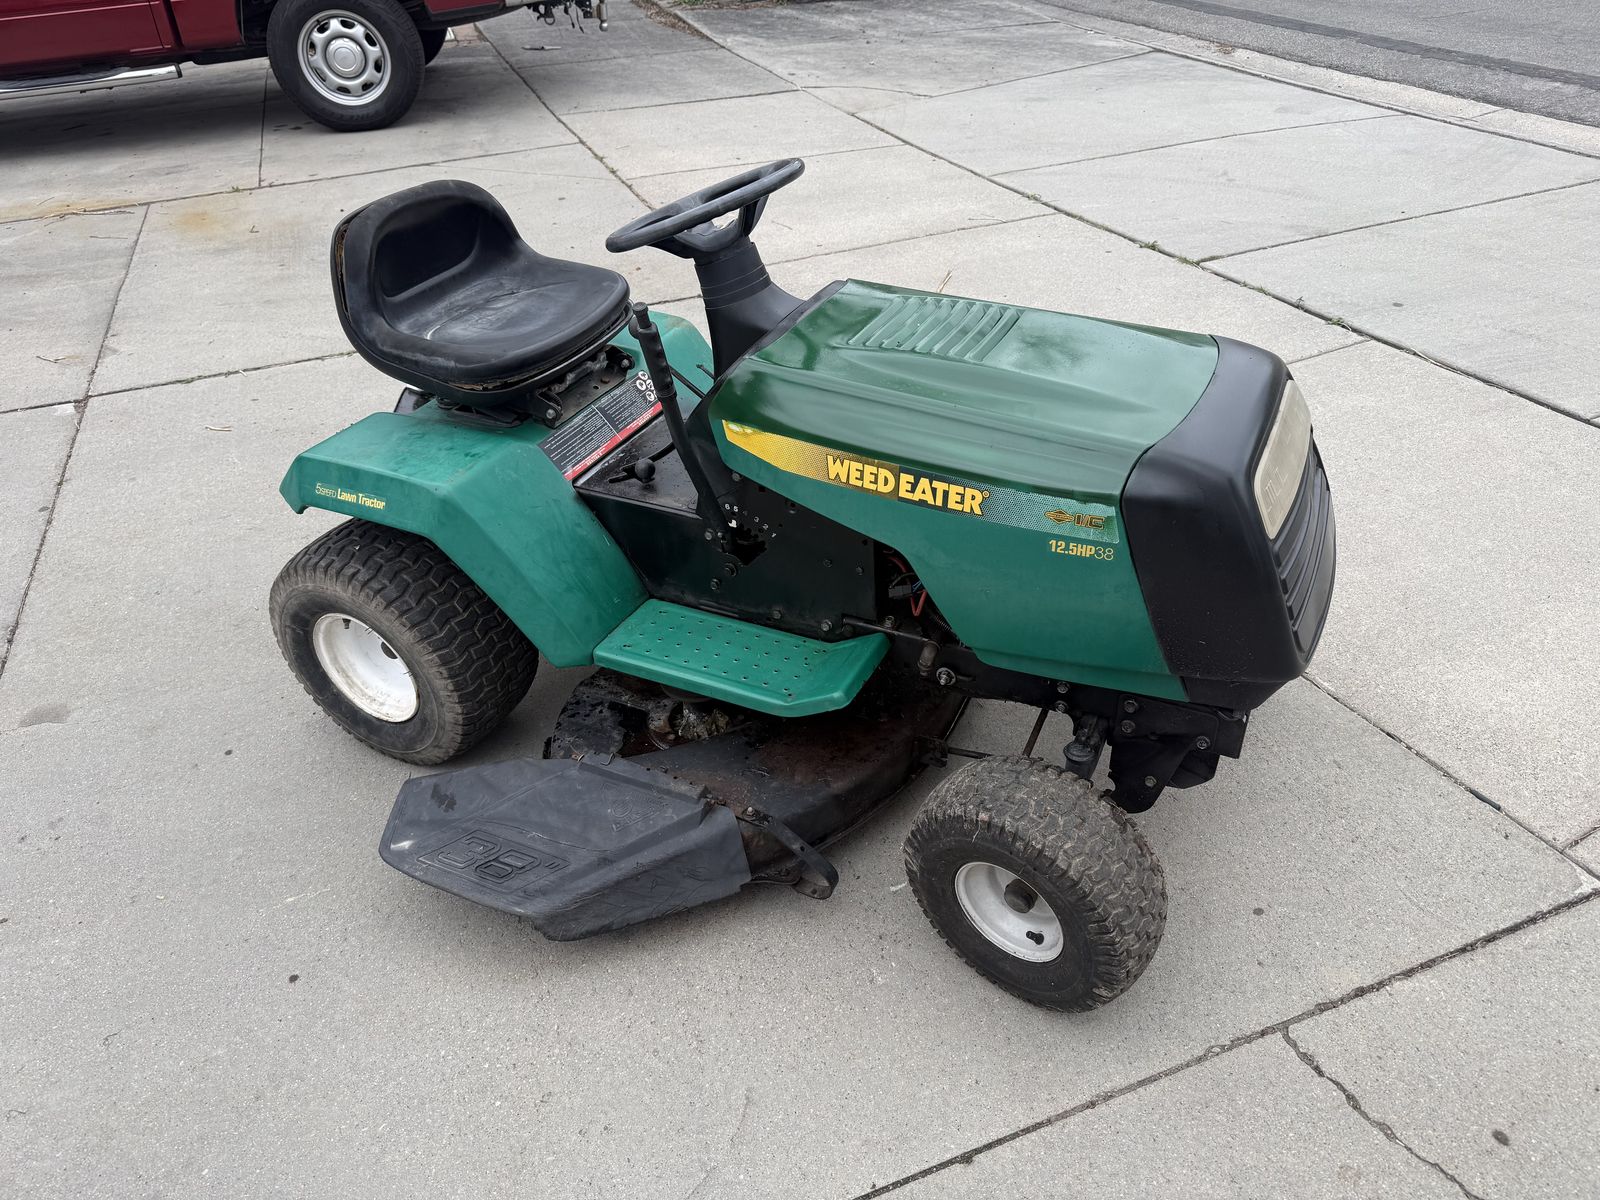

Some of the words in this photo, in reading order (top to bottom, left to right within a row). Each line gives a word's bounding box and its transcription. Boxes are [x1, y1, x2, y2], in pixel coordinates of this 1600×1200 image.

[826, 454, 896, 493] WEED
[337, 488, 356, 503] Lawn
[358, 492, 386, 510] Tractor
